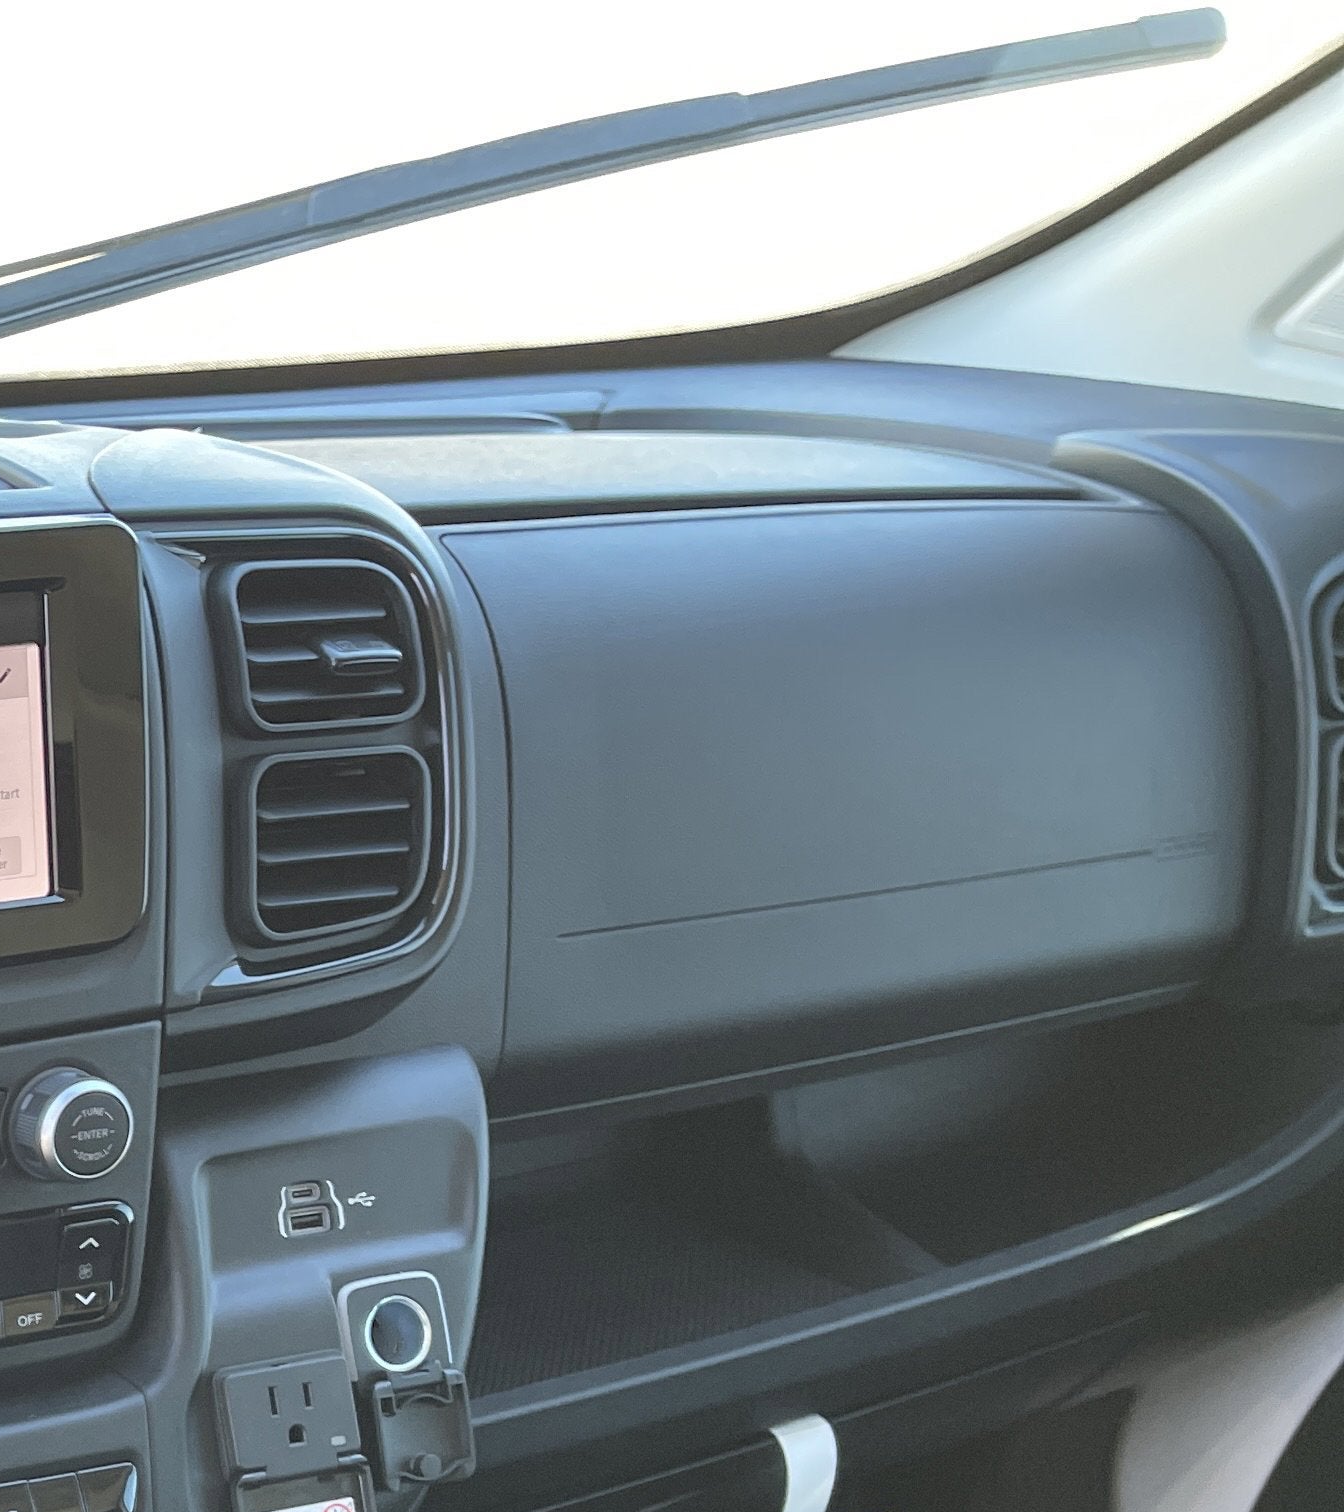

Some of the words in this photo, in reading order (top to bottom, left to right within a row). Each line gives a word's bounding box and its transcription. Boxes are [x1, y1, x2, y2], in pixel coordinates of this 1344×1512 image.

[81, 1106, 106, 1118] TUNE
[76, 1127, 109, 1142] ENTER
[75, 1147, 110, 1162] SCROLL
[16, 1312, 43, 1327] OFF
